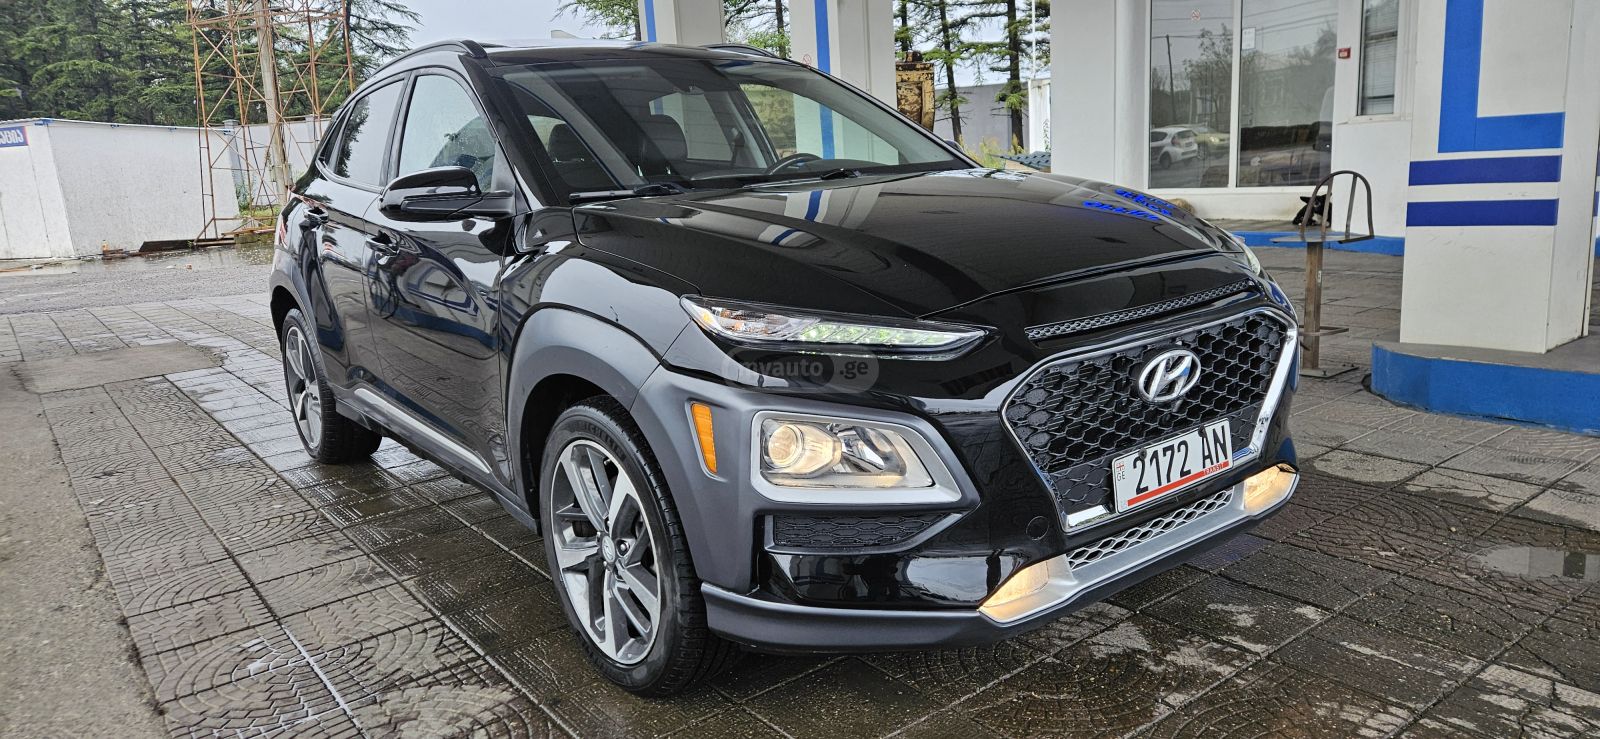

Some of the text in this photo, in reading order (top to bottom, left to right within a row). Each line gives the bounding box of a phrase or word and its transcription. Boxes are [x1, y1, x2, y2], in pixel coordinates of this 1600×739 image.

[1116, 471, 1126, 482] GE
[1133, 425, 1228, 495] 2172 AN
